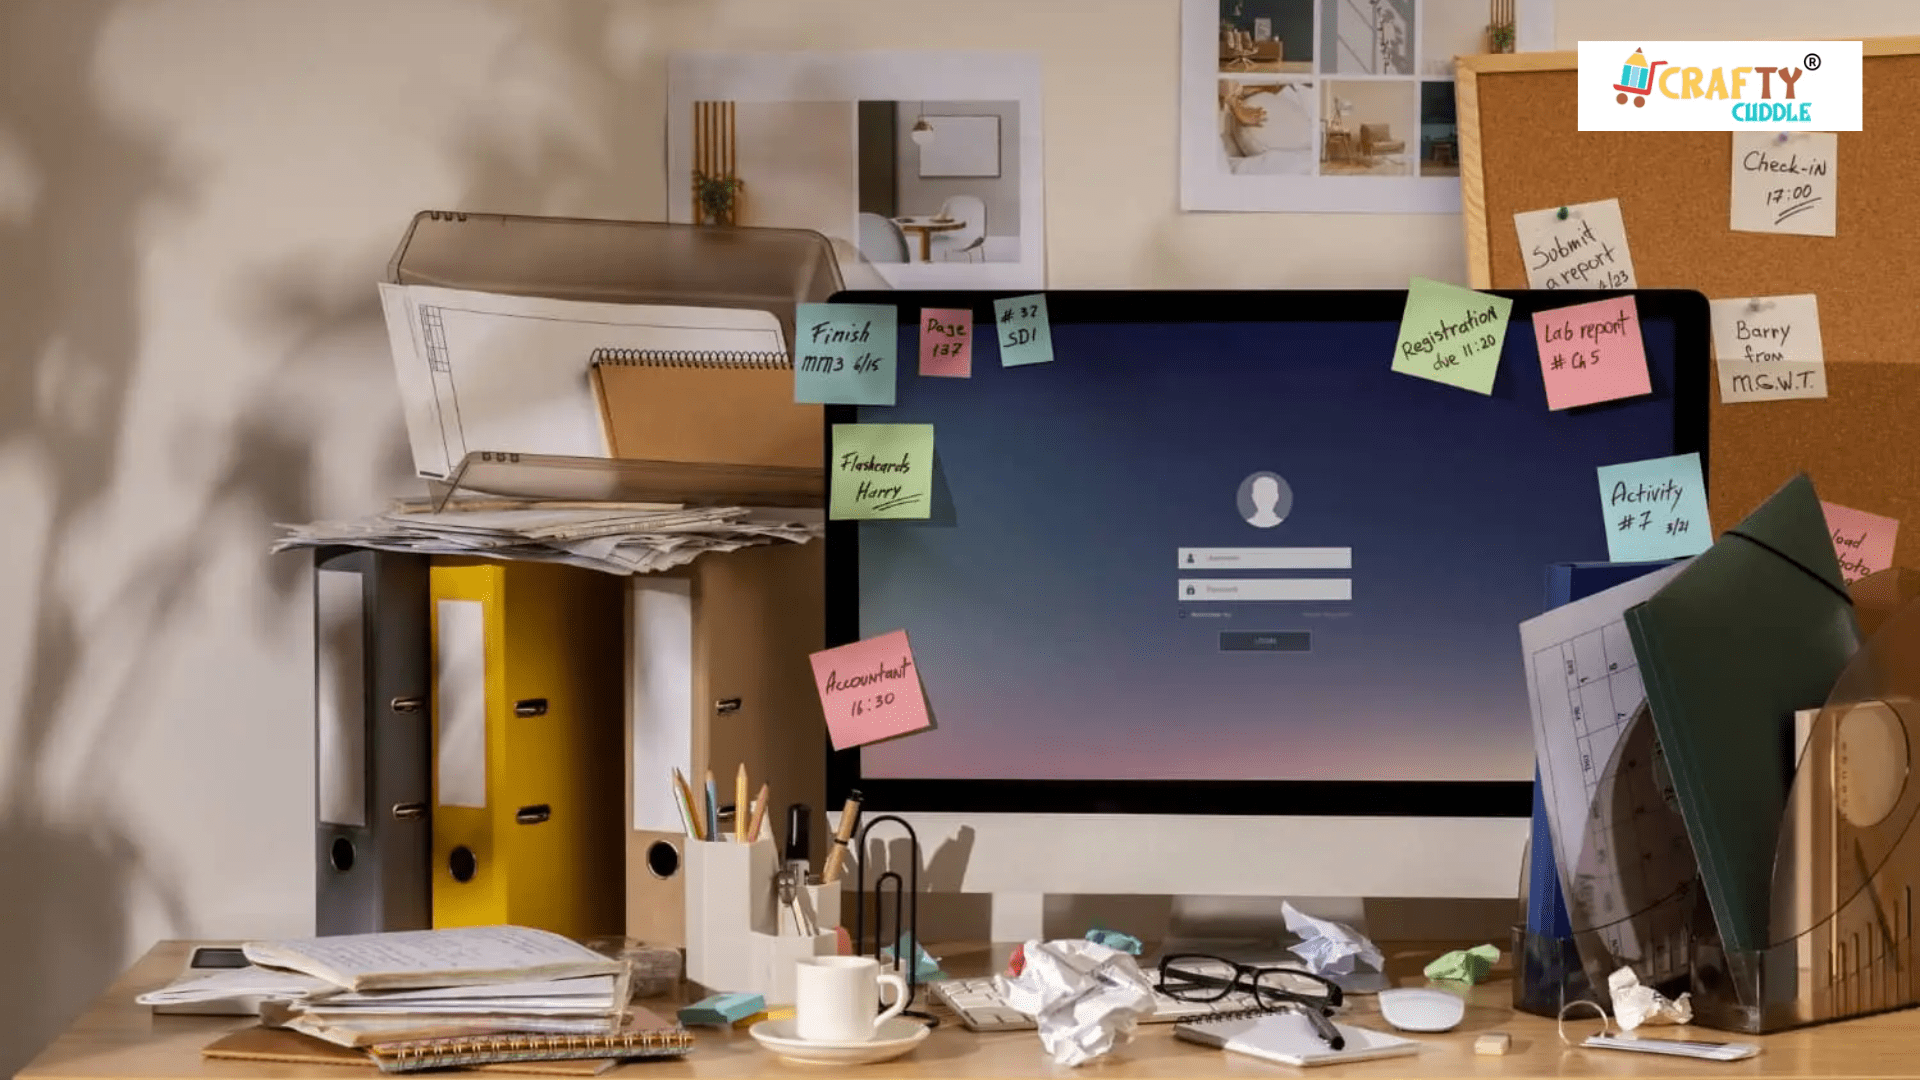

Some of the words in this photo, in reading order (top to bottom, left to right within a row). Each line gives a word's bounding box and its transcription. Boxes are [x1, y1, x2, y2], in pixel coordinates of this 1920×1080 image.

[1766, 184, 1813, 206] 17:00
[1532, 219, 1597, 271] Submit
[1546, 277, 1560, 290] a
[1560, 242, 1615, 285] report
[811, 320, 872, 345] Finish
[927, 318, 967, 337] Page
[1545, 321, 1574, 343] Lab
[1581, 309, 1631, 344] report
[1736, 320, 1791, 346] Barry
[932, 343, 963, 358] 137
[1433, 355, 1460, 371] due
[1463, 334, 1496, 358] 11:20
[1590, 349, 1600, 365] 5
[1745, 345, 1785, 363] from
[853, 354, 883, 375] 6/15
[840, 451, 911, 474] Flashcards
[855, 481, 902, 502] Harry
[1611, 478, 1684, 513] Activity
[851, 692, 895, 718] 16:30
